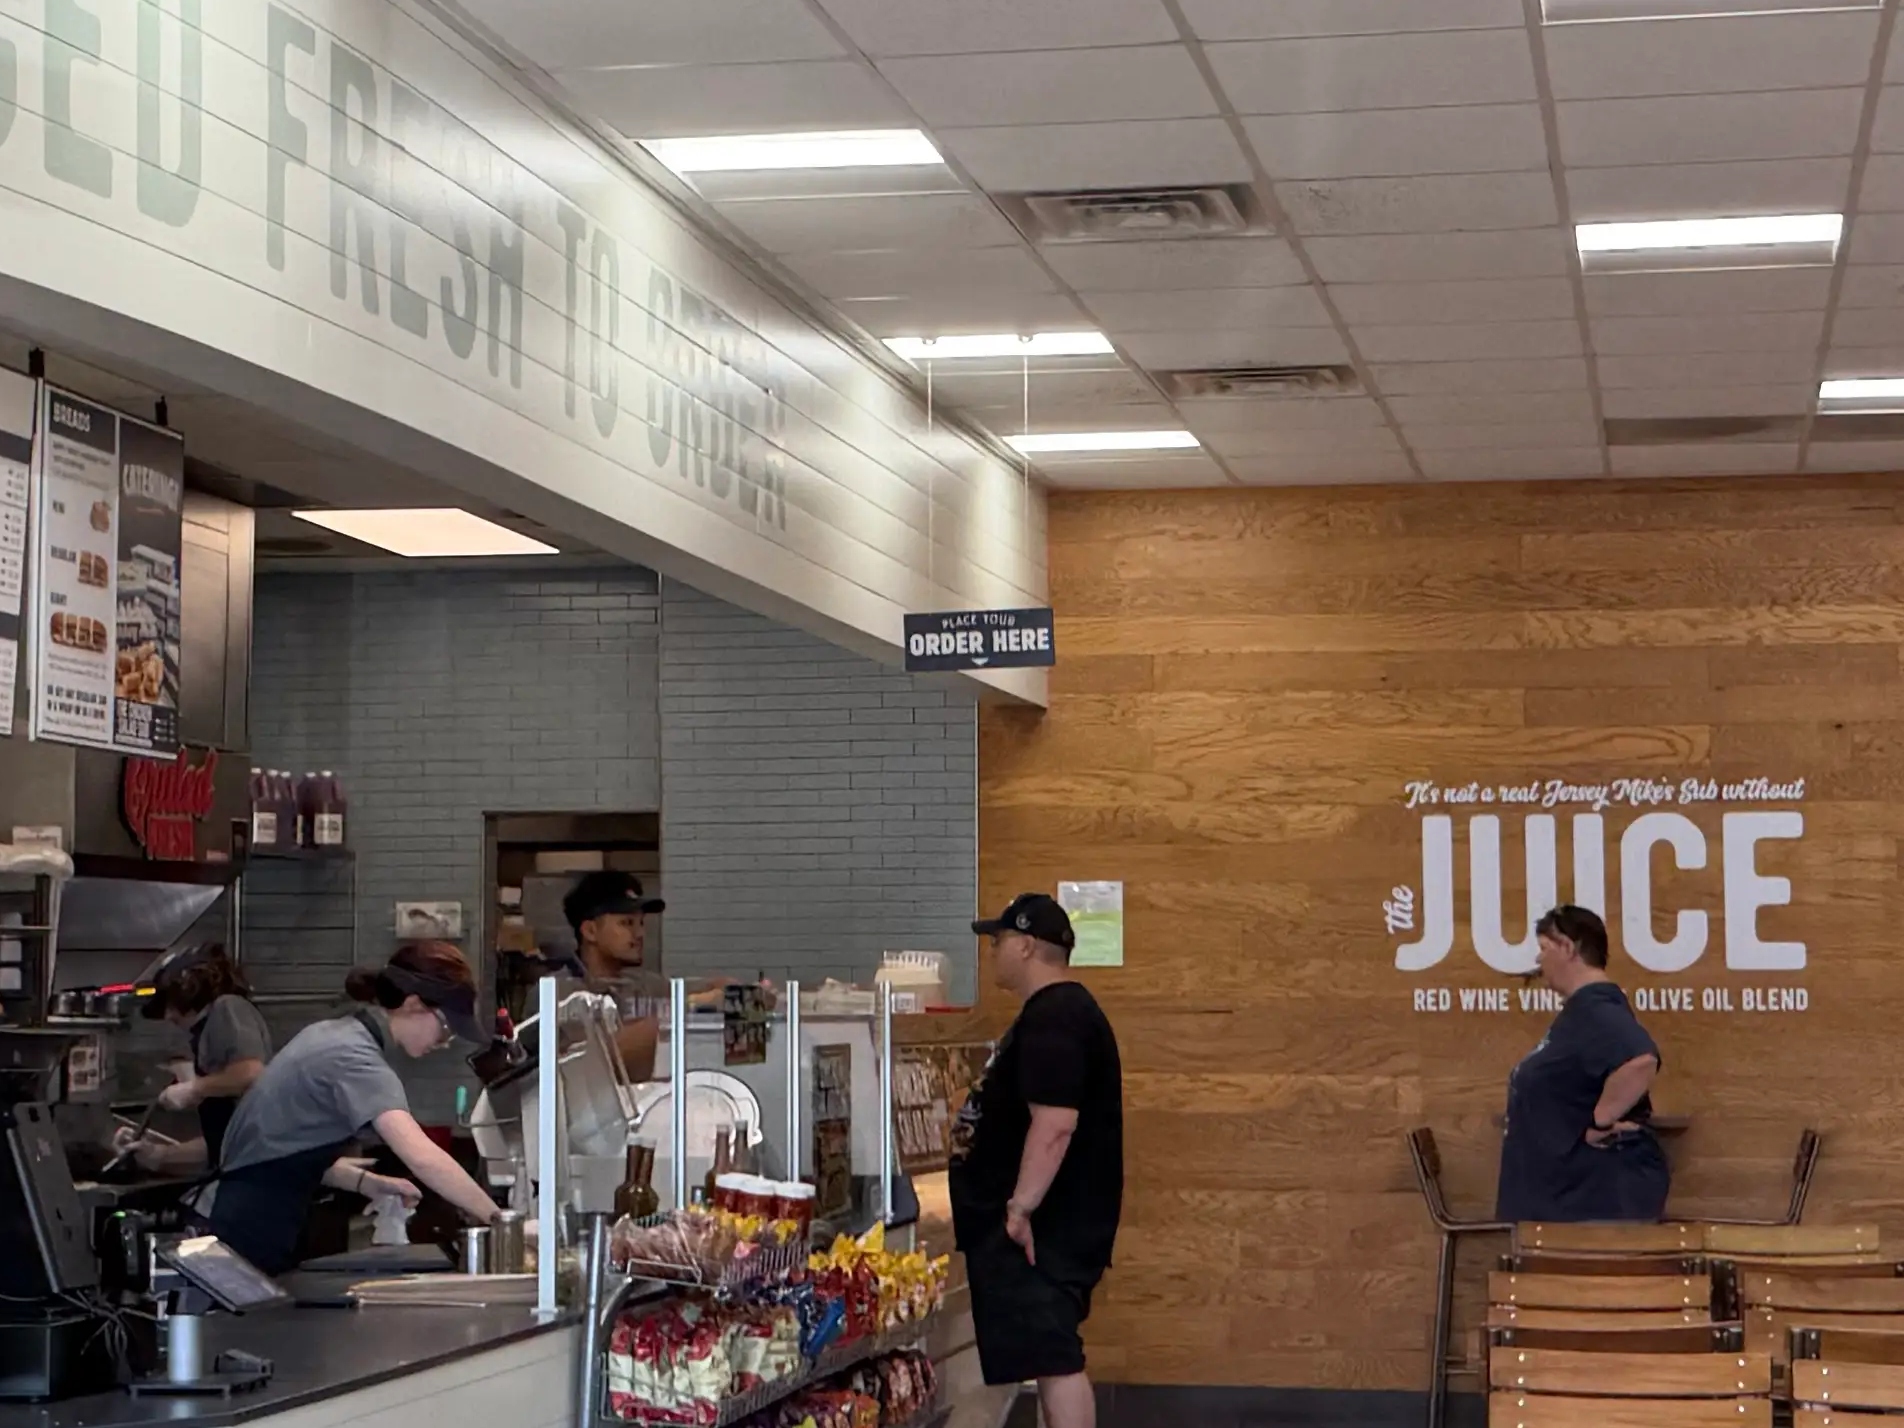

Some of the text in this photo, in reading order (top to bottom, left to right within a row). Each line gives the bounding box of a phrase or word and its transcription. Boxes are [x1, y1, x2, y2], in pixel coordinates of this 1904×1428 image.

[262, 0, 524, 391] FRESH
[558, 199, 620, 439] TO
[649, 265, 786, 532] ORDER
[53, 401, 91, 433] BREADS
[942, 613, 1016, 629] PLACE YOUR
[910, 628, 1050, 656] ORDER HERE
[1405, 776, 1805, 811] It's not a real Jersey Mike's Sub without
[1394, 811, 1807, 974] JUICE
[1383, 885, 1414, 936] the
[1413, 988, 1809, 1012] RED WINE VINE OLIVE OIL BLEND
